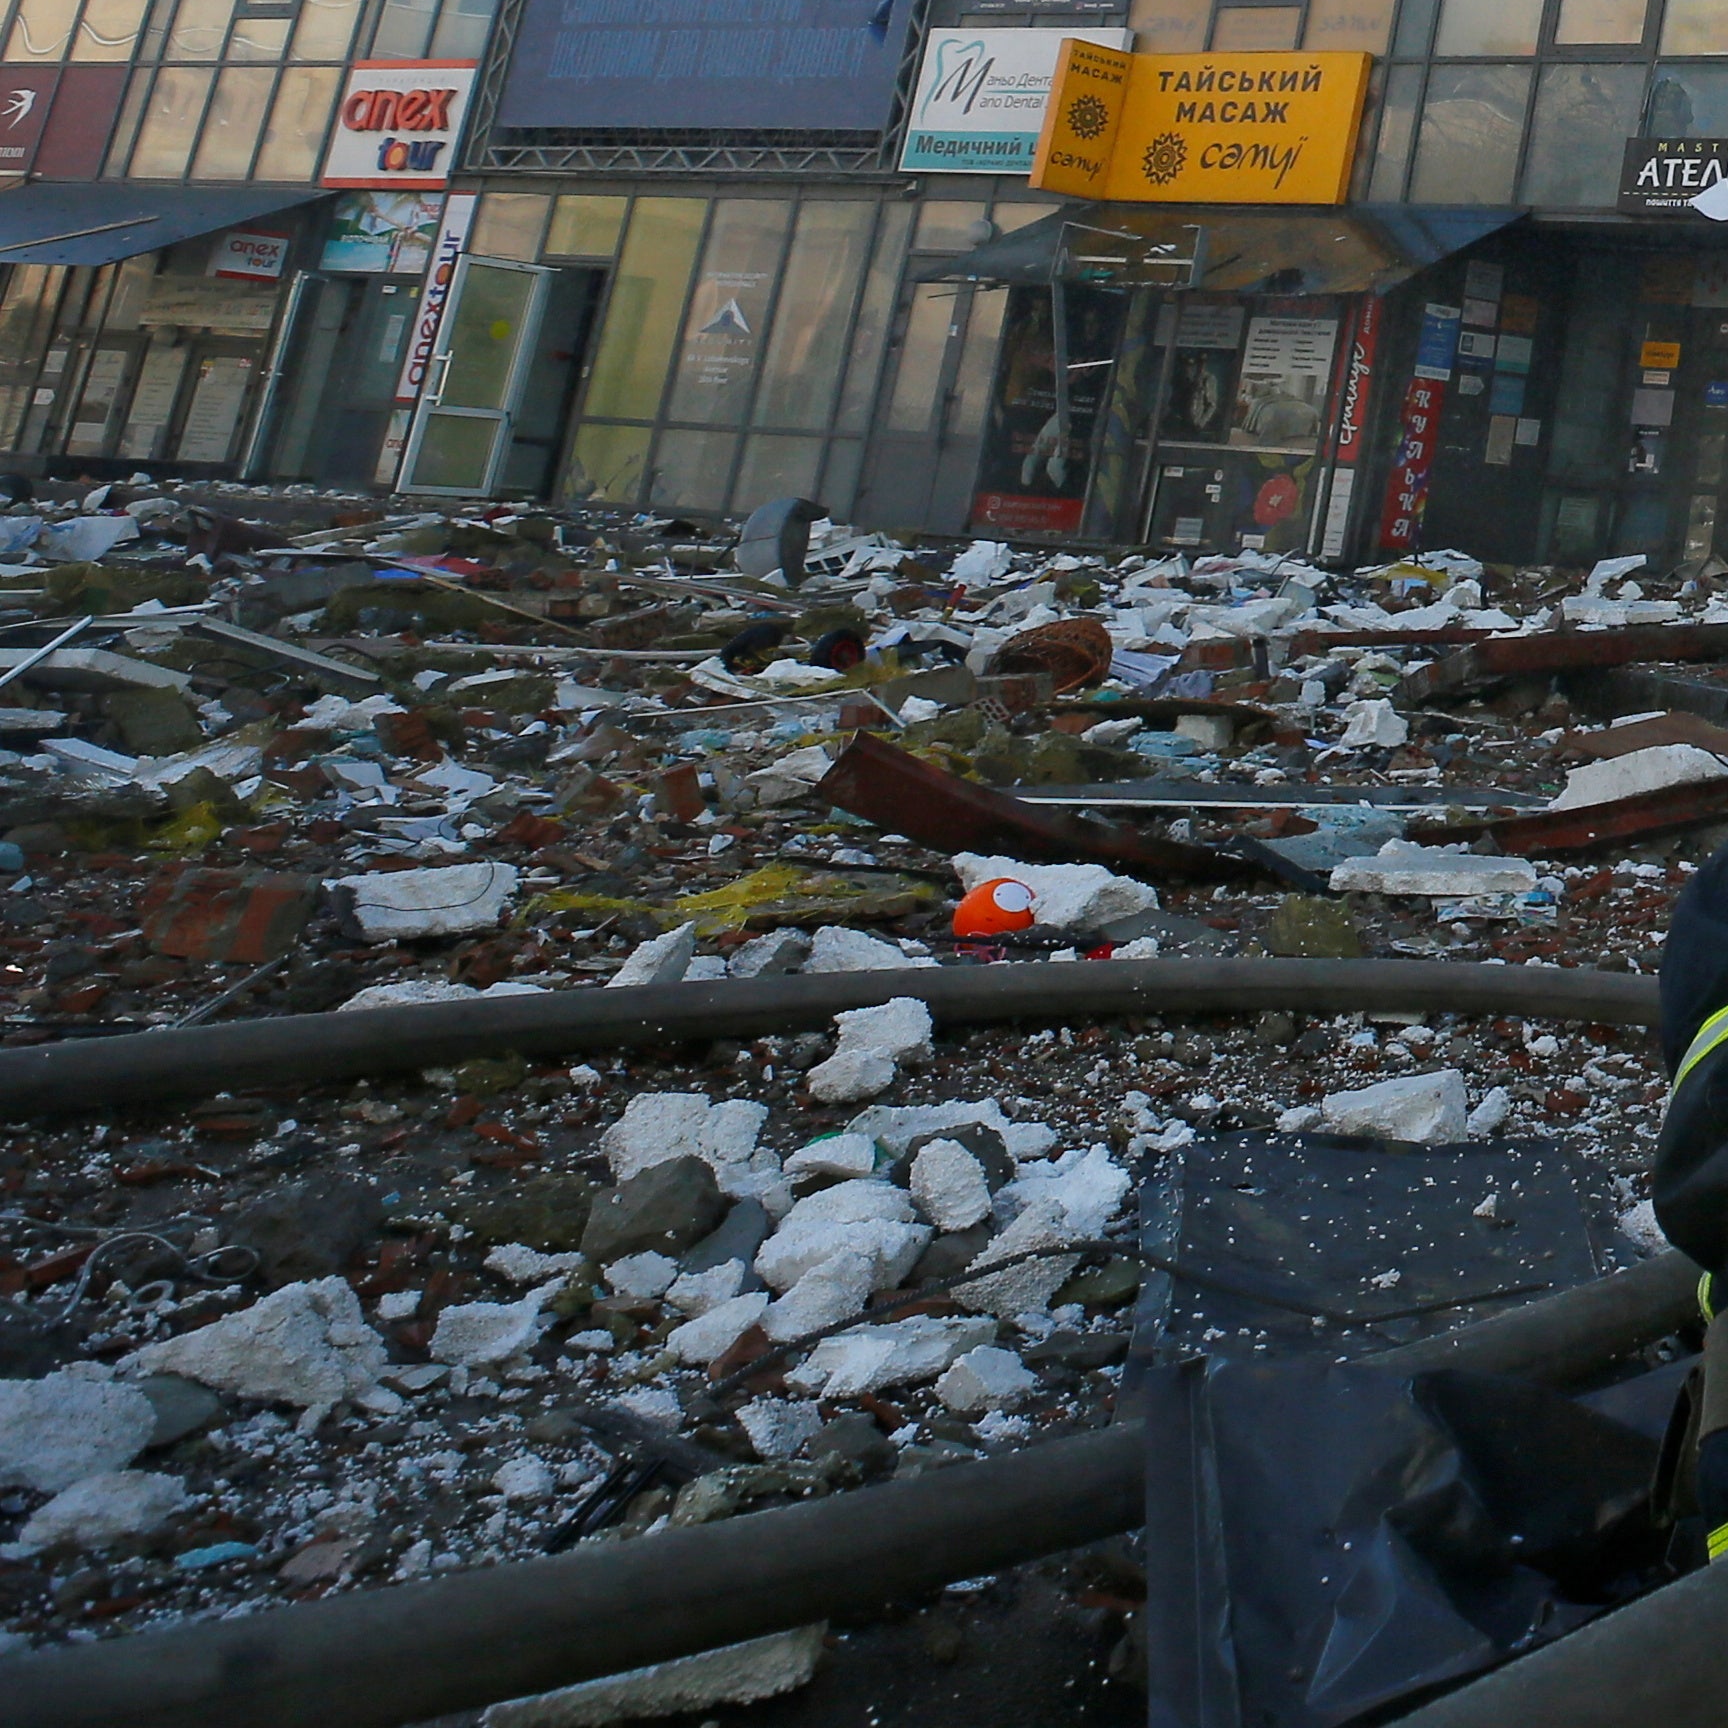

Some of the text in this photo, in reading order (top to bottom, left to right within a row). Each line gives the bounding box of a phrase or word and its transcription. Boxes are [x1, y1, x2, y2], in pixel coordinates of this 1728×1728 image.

[1073, 49, 1127, 70] ТАЙСЬКИЙ
[1070, 62, 1123, 85] МАСАЖ
[1157, 64, 1324, 94] ТАЙСЬКИЙ
[341, 88, 459, 133] anex
[1003, 95, 1044, 110] Dental
[1175, 101, 1288, 124] МАСАЖ
[376, 137, 448, 172] tour
[915, 135, 1021, 159] Медичний
[229, 238, 281, 258] anex
[247, 254, 277, 270] tour
